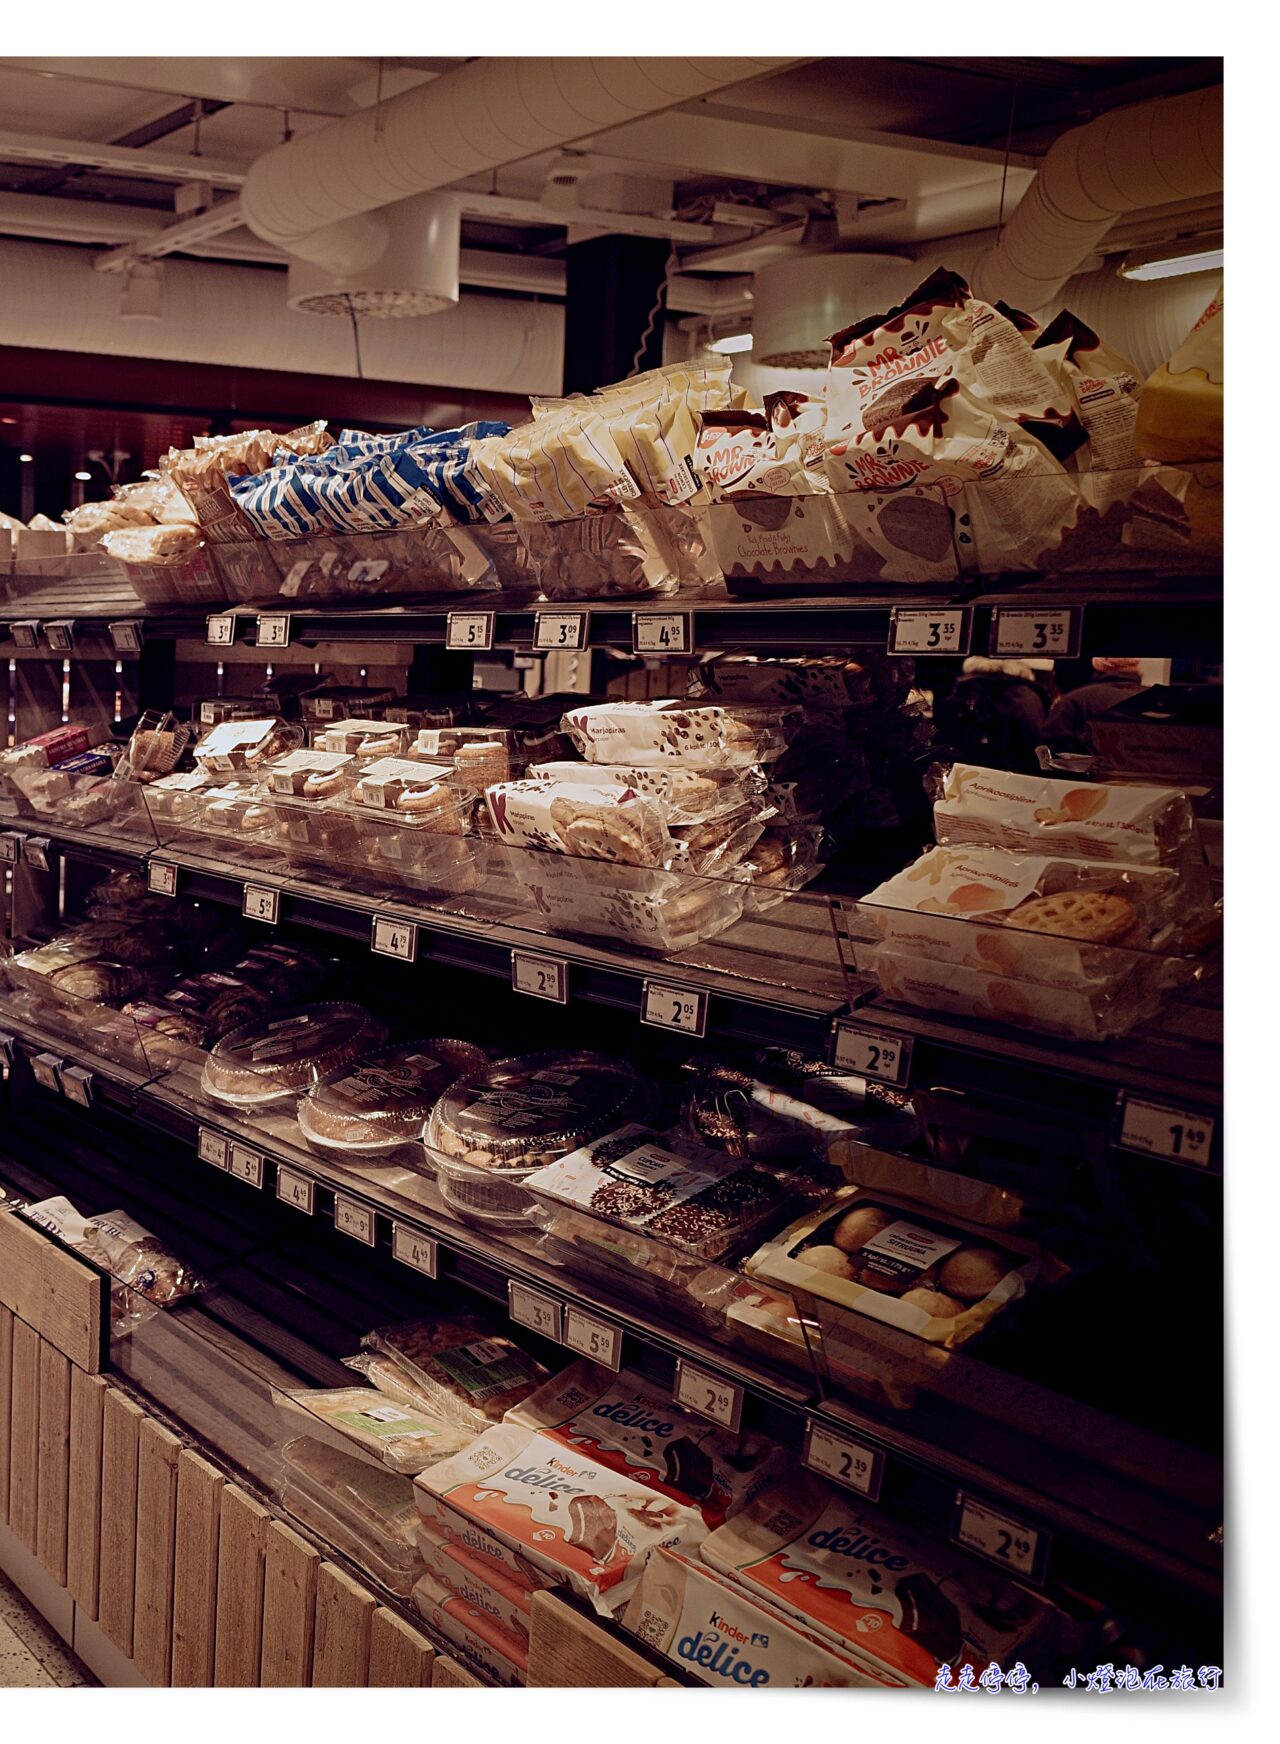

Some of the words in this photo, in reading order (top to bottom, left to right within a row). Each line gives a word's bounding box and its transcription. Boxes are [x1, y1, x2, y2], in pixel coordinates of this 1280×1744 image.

[858, 335, 949, 399] BROWNIE
[927, 623, 941, 647] 3
[943, 623, 955, 634] 35
[1032, 623, 1047, 648] 3
[1050, 623, 1063, 635] 35
[671, 1001, 682, 1024] 2
[684, 1003, 694, 1015] 05
[866, 1045, 880, 1071] 2
[882, 1049, 895, 1062] 99
[1169, 1125, 1183, 1154] 1
[1186, 1129, 1205, 1144] 49
[590, 1332, 600, 1354] 5
[601, 1336, 610, 1348] 59
[705, 1389, 716, 1413] 2
[717, 1393, 729, 1407] 49
[546, 1455, 578, 1479] Kinder
[839, 1452, 852, 1478] 2
[854, 1458, 867, 1472] 39
[504, 1466, 585, 1496] délice
[996, 1530, 1011, 1559] 2
[1014, 1537, 1030, 1554] 49
[709, 1611, 749, 1645] Kinder
[677, 1631, 770, 1688] délice
